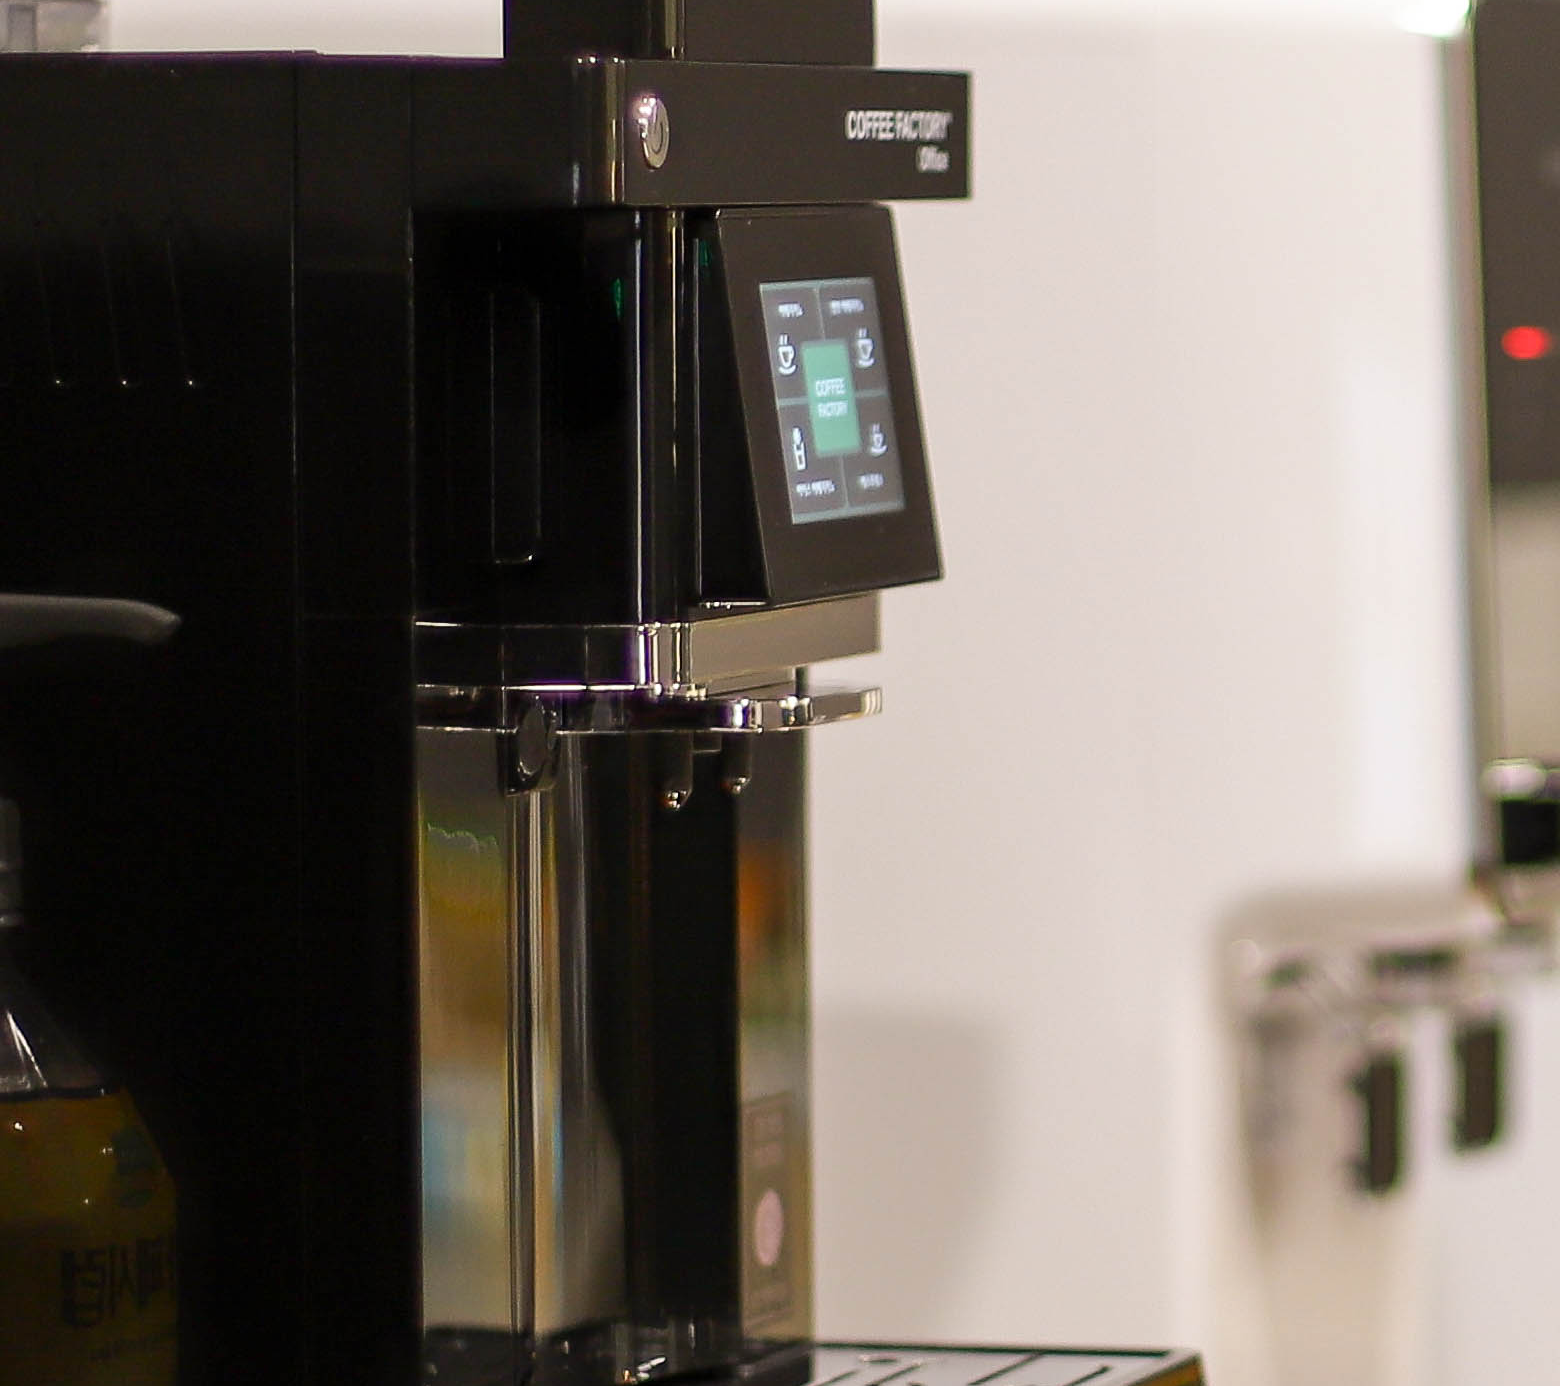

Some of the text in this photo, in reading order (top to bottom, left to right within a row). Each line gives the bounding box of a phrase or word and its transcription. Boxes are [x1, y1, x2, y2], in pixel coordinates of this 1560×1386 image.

[845, 110, 949, 141] COFFEE FACTORY
[815, 377, 846, 397] COFFEE
[818, 399, 849, 418] FACTORY
